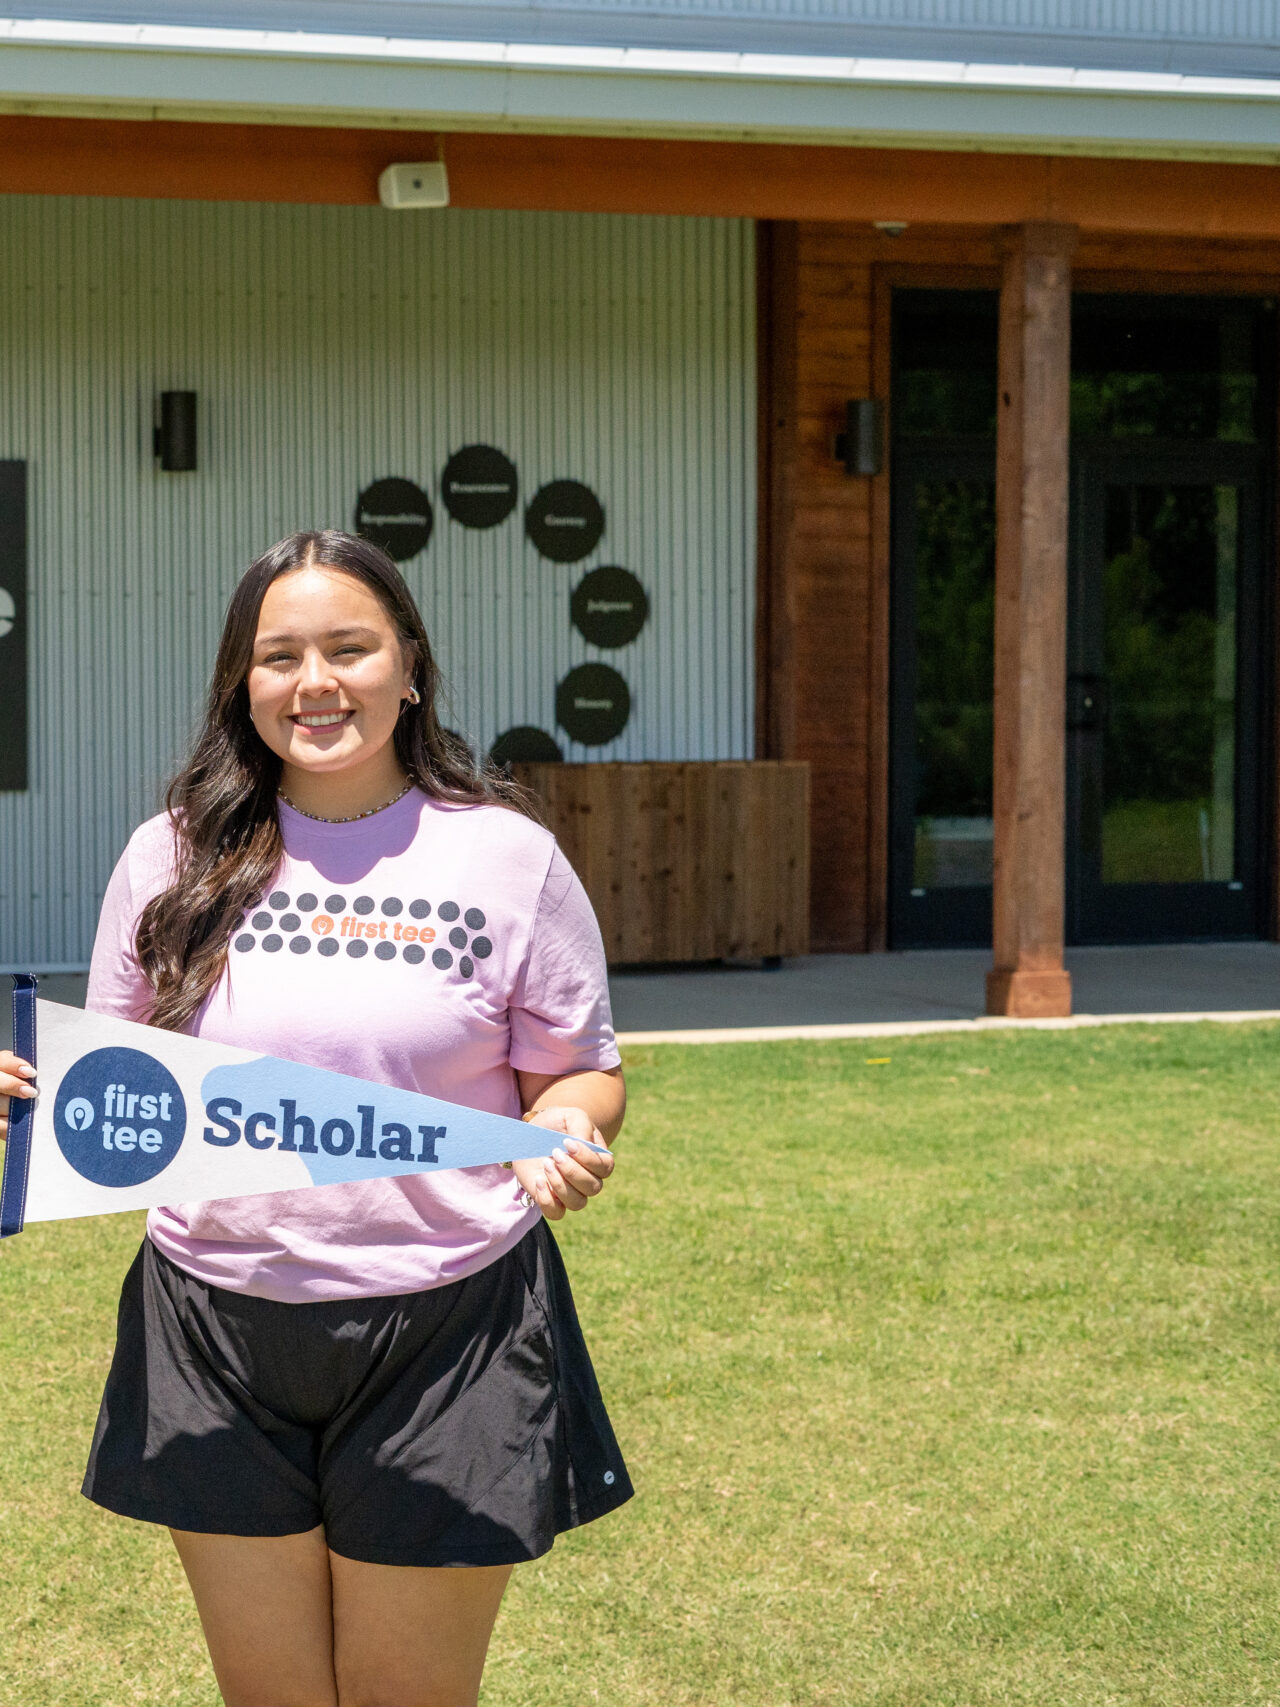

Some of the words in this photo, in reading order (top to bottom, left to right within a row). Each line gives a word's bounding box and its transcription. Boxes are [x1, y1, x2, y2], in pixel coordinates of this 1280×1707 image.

[340, 916, 387, 939] first
[393, 922, 436, 943] tee
[103, 1083, 173, 1121] first
[101, 1120, 163, 1154] tee
[202, 1097, 447, 1163] Scholar
